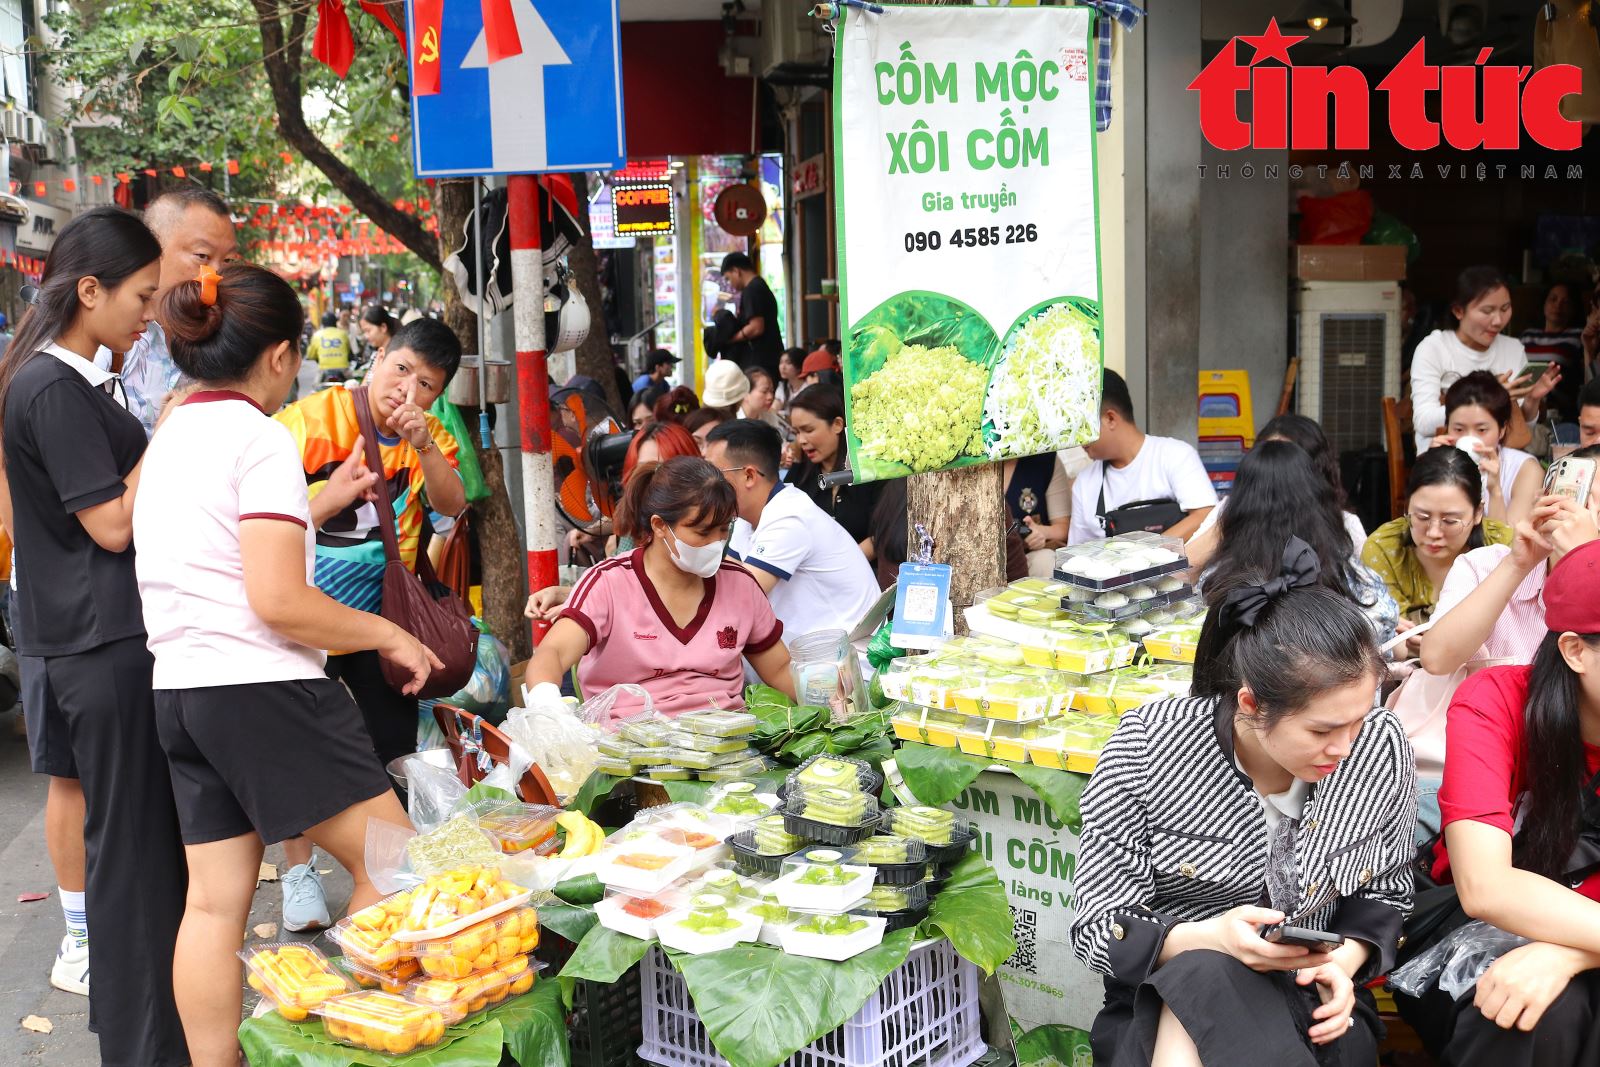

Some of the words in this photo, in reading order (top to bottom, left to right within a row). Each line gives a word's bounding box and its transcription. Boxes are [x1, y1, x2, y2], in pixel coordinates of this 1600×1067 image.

[874, 40, 958, 106] CỐM
[975, 49, 1060, 114] MỘC
[886, 119, 950, 175] XÔI
[966, 107, 1050, 171] CỐM
[921, 191, 954, 213] Gia
[960, 182, 1017, 214] truyền
[904, 231, 942, 253] 090
[949, 227, 1000, 248] 4585
[1005, 223, 1038, 244] 226
[321, 335, 342, 349] be
[1006, 837, 1076, 884] CỐM
[1011, 879, 1054, 908] làng
